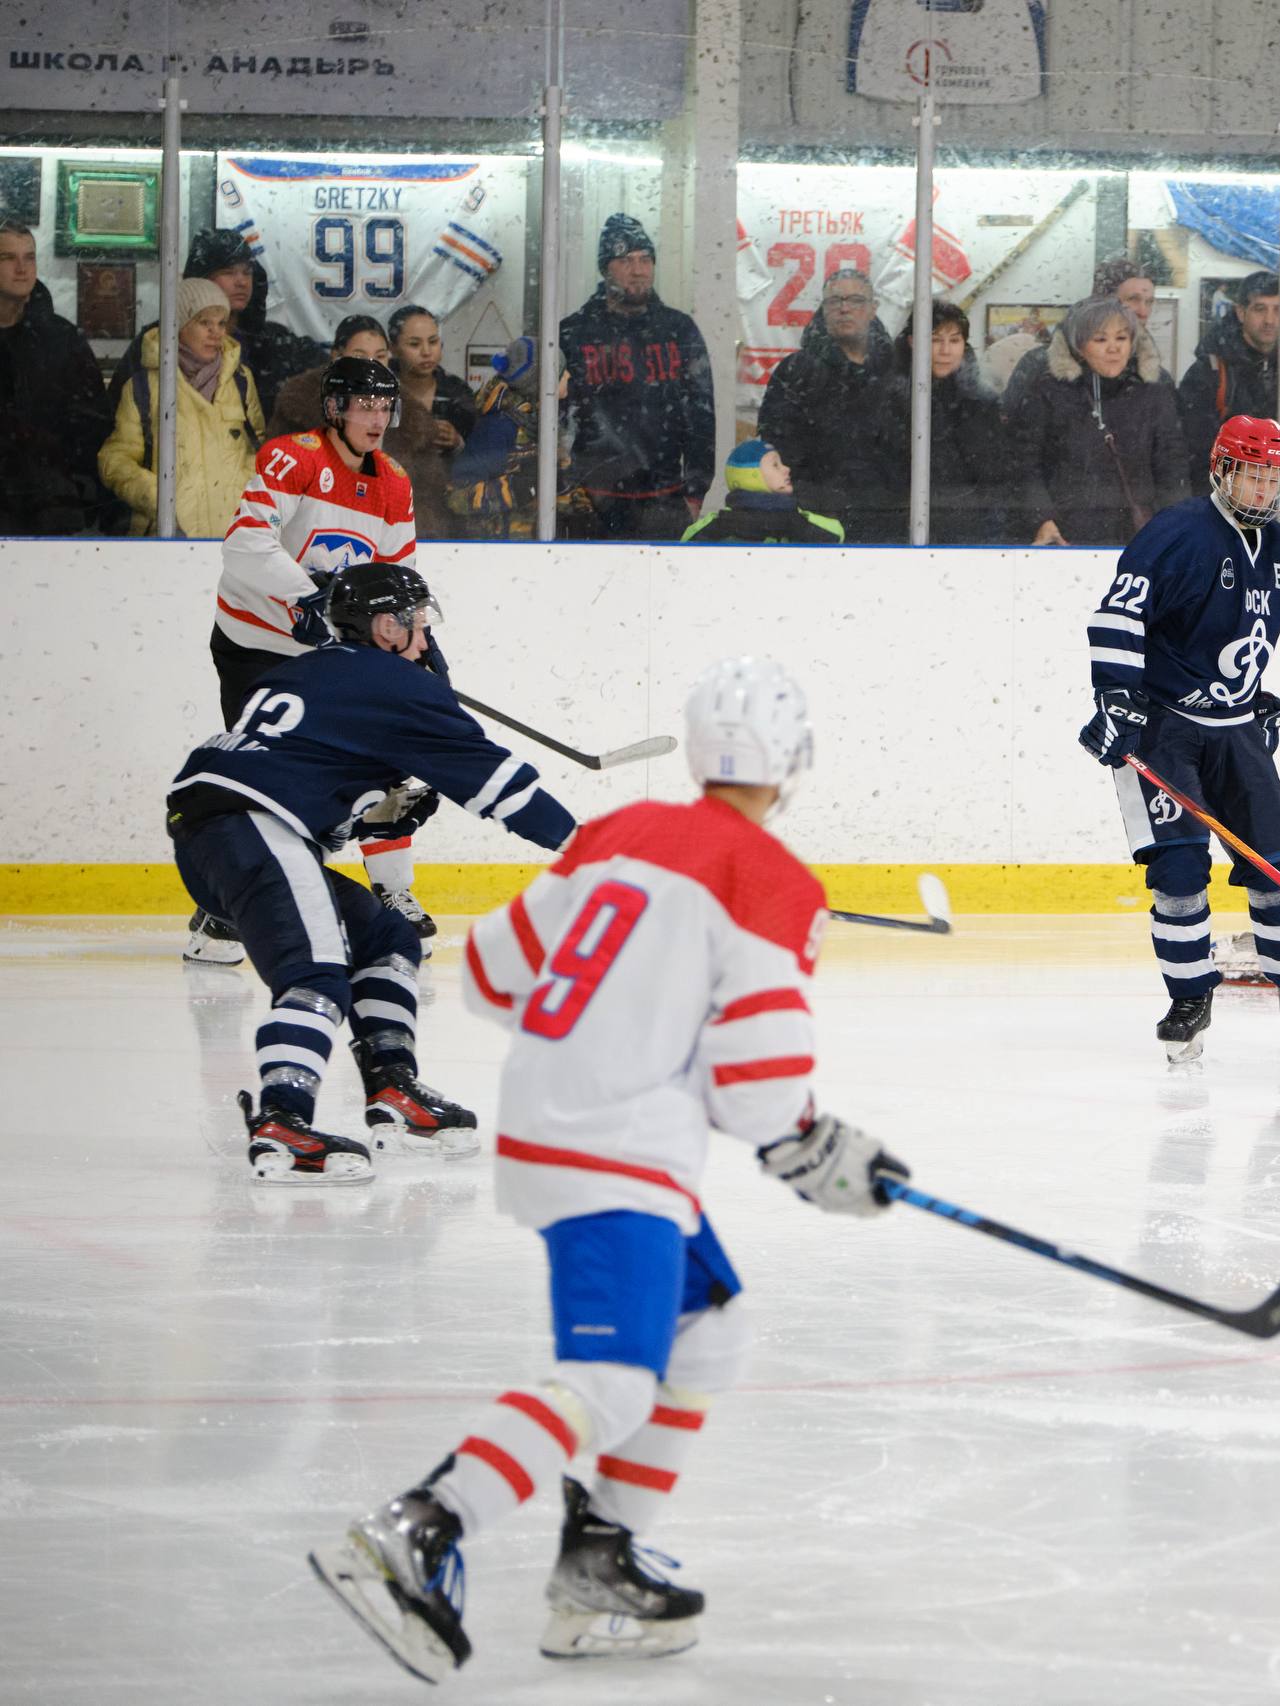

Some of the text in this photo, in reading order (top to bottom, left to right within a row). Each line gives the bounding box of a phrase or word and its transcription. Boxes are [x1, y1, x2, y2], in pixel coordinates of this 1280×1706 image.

[9, 51, 144, 71] ШКОЛА
[206, 55, 395, 77] АНАДЫРЬ
[314, 186, 403, 210] GRETZKY
[778, 209, 864, 235] ТРЕТЬЯК
[312, 215, 408, 300] 99
[265, 448, 298, 481] 27
[1108, 573, 1150, 614] 22
[520, 879, 649, 1041] 9
